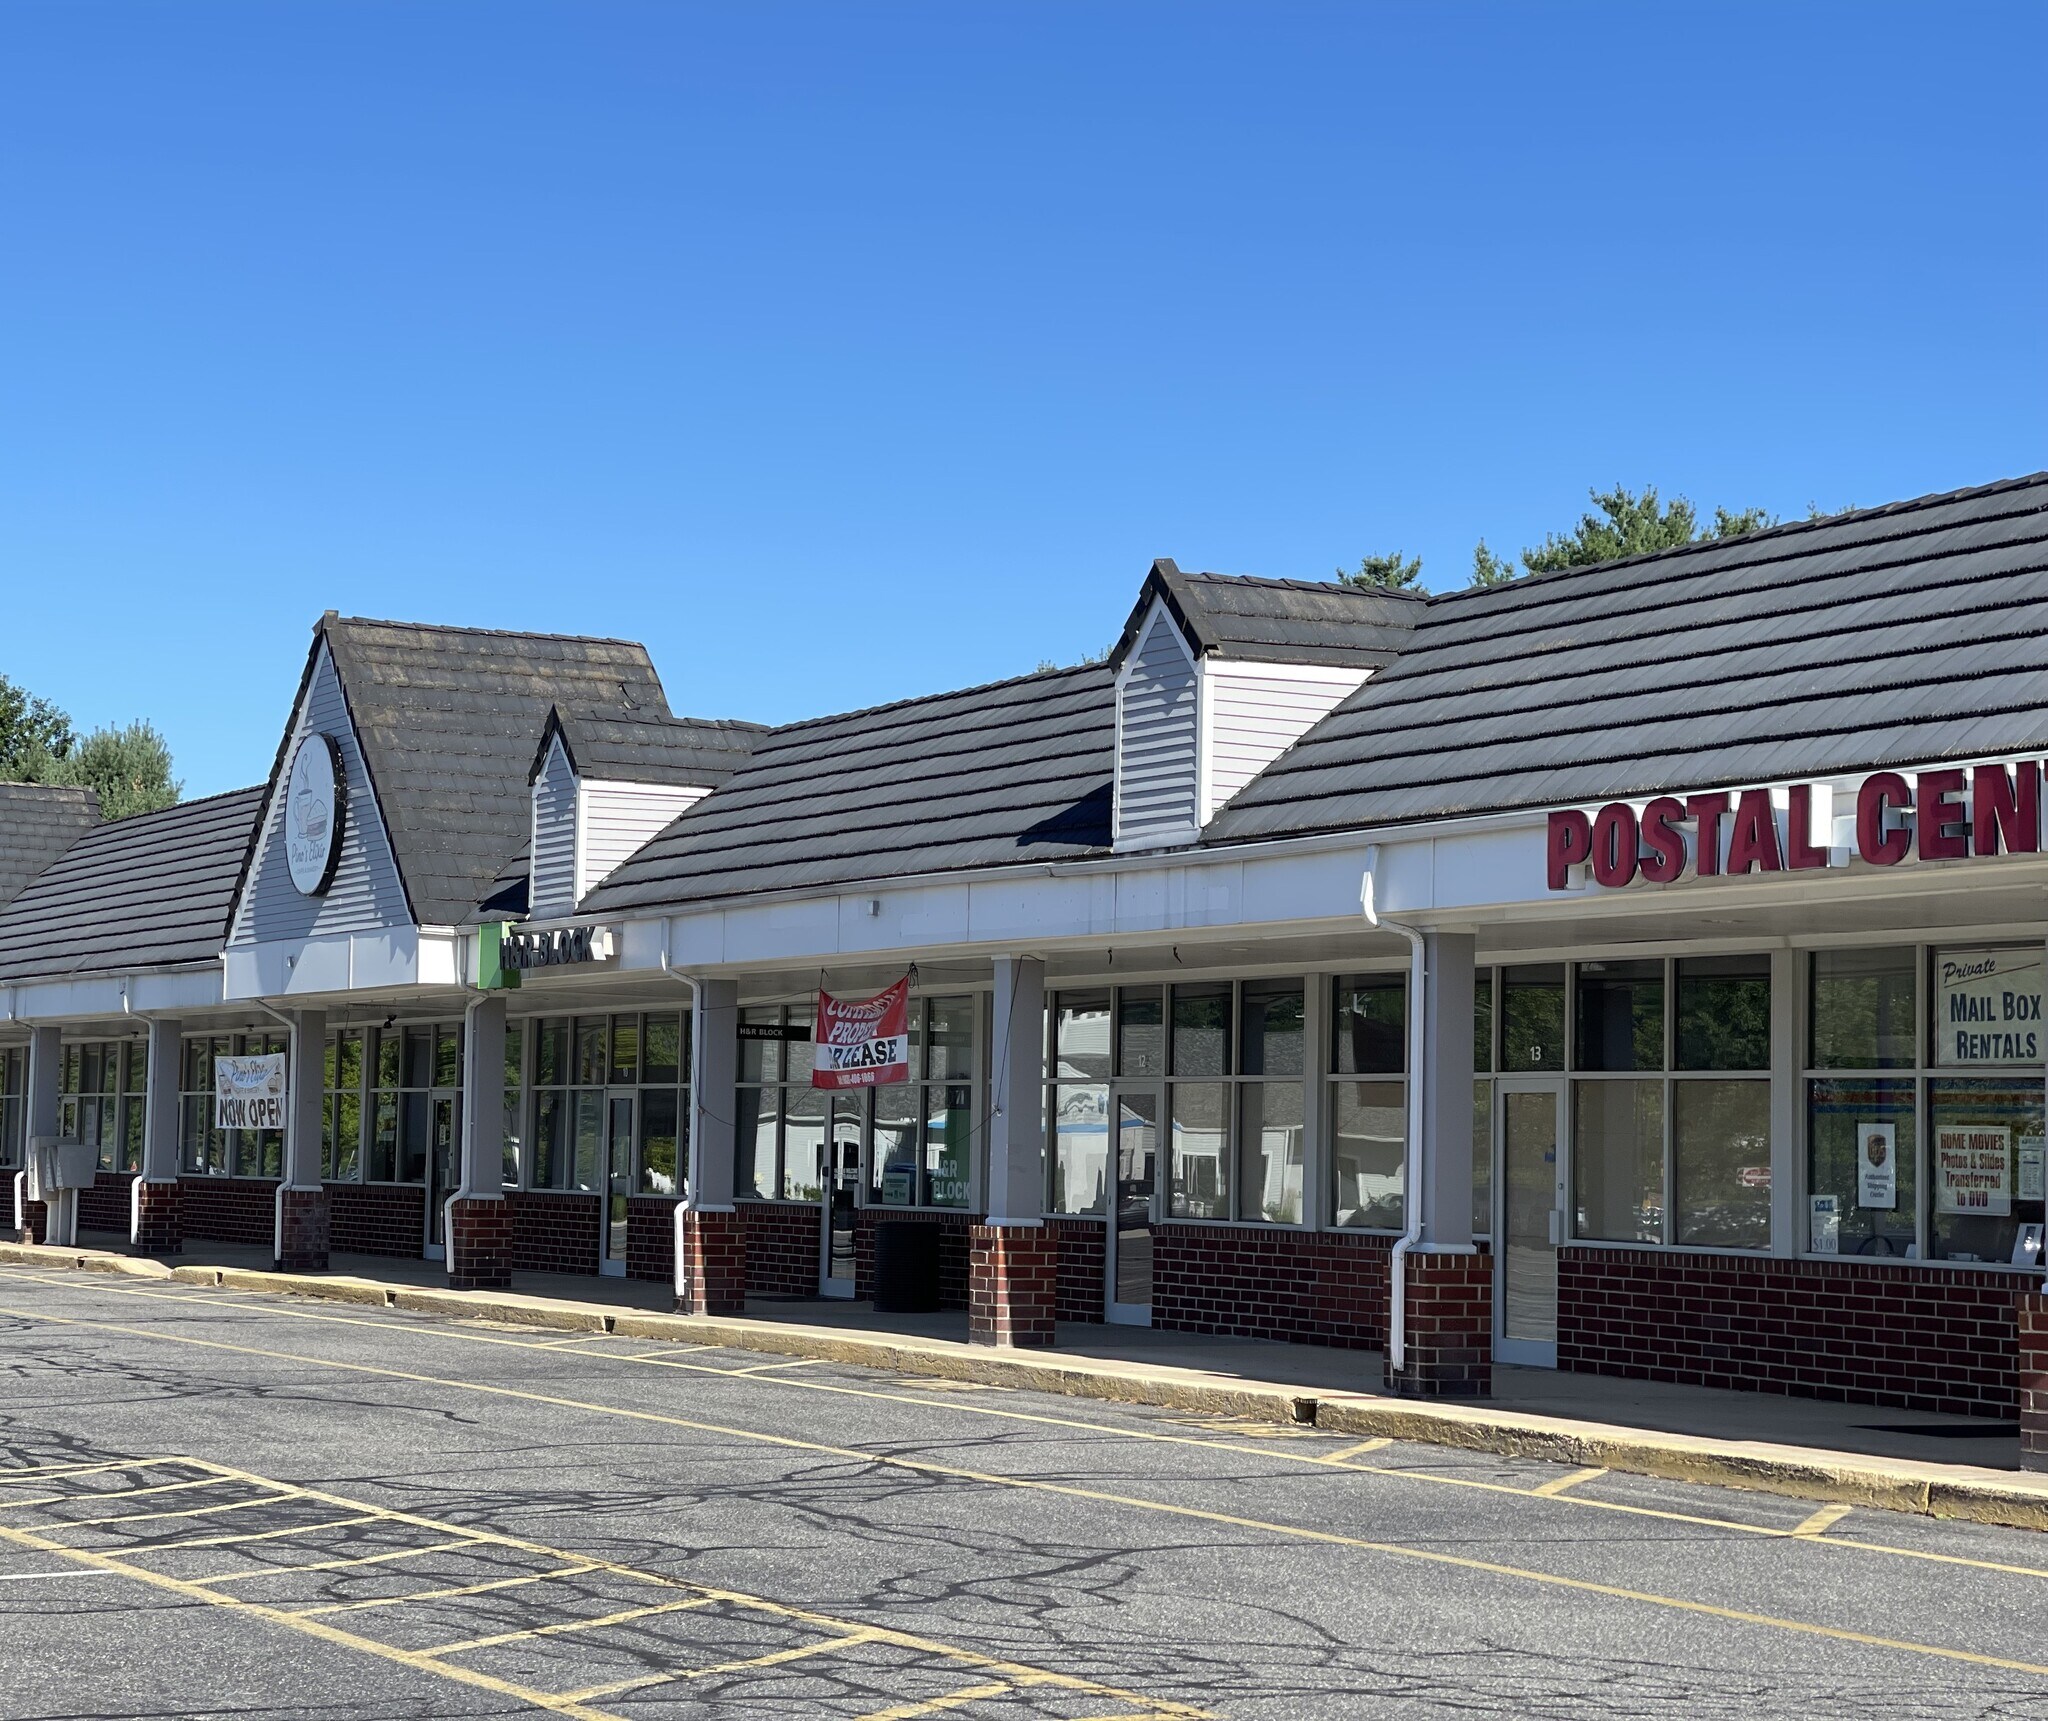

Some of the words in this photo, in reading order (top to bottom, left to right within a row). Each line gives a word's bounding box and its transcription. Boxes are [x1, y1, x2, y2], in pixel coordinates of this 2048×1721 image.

[1547, 784, 1832, 890] POSTAL
[1856, 759, 2048, 866] CEN
[500, 931, 534, 969] H&R
[537, 926, 596, 966] BLOCK
[1943, 958, 1996, 984] Private
[1950, 993, 1996, 1022] MAIL
[2003, 991, 2041, 1021] BOX
[759, 1028, 783, 1036] BLOCK
[842, 1039, 898, 1068] LEASE
[1530, 1046, 1541, 1060] 13
[1957, 1031, 2037, 1059] RENTALS
[1138, 1055, 1146, 1067] 12
[220, 1098, 246, 1127] NOW
[248, 1098, 283, 1127] OPEN
[1940, 1133, 1966, 1150] HOME
[1968, 1134, 2005, 1151] MOVIES
[1941, 1152, 1967, 1169] Photos
[1970, 1152, 1977, 1169] &
[1979, 1153, 2005, 1170] Slides
[933, 1180, 970, 1200] BLOCK
[1945, 1171, 2001, 1189] Transferred
[1957, 1191, 1965, 1206] to
[1968, 1191, 1988, 1207] DVD
